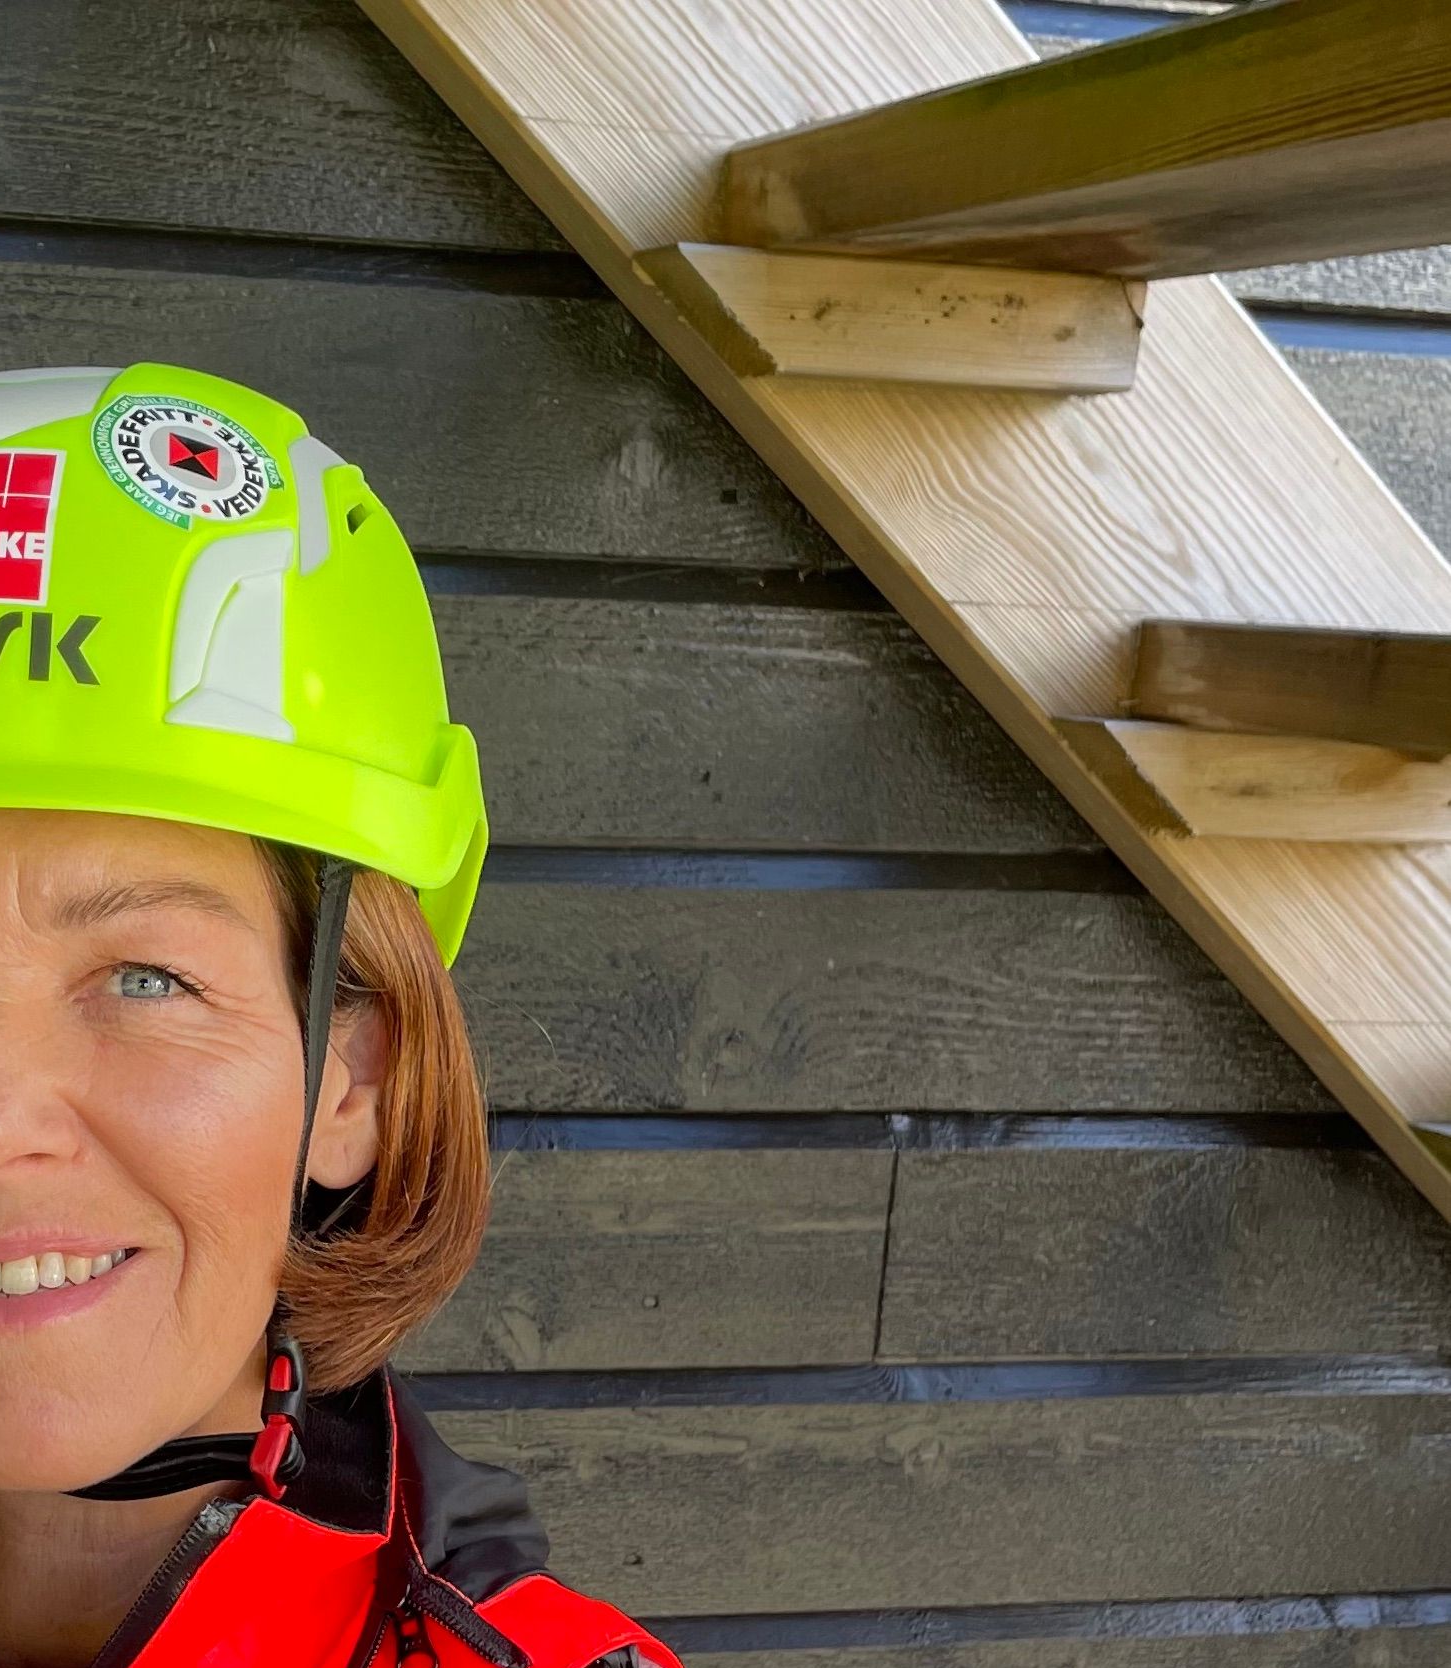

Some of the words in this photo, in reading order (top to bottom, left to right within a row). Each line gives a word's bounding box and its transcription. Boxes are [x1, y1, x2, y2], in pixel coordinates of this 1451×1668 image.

[117, 408, 199, 509] SKADEFRITT
[213, 426, 264, 519] VEIDEKKE
[124, 482, 155, 509] HAR
[154, 504, 182, 524] JEG
